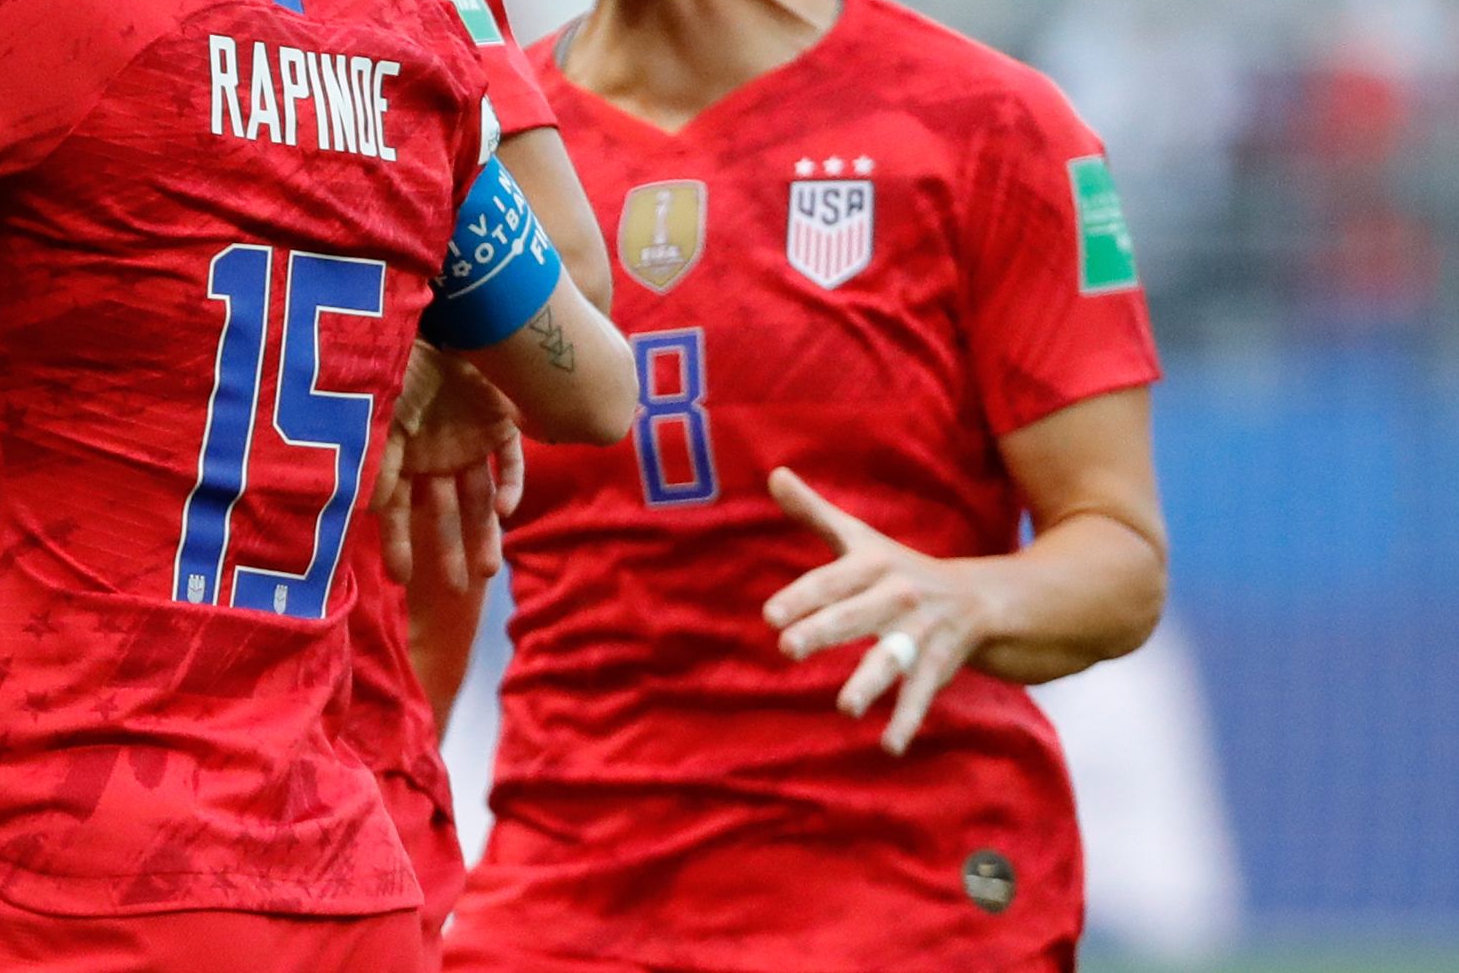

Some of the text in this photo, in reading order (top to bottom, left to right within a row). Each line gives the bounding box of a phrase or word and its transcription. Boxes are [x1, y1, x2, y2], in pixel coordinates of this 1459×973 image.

[209, 34, 401, 162] RAPINOE
[797, 188, 864, 226] USA
[171, 243, 386, 619] 15
[629, 326, 720, 511] 8
